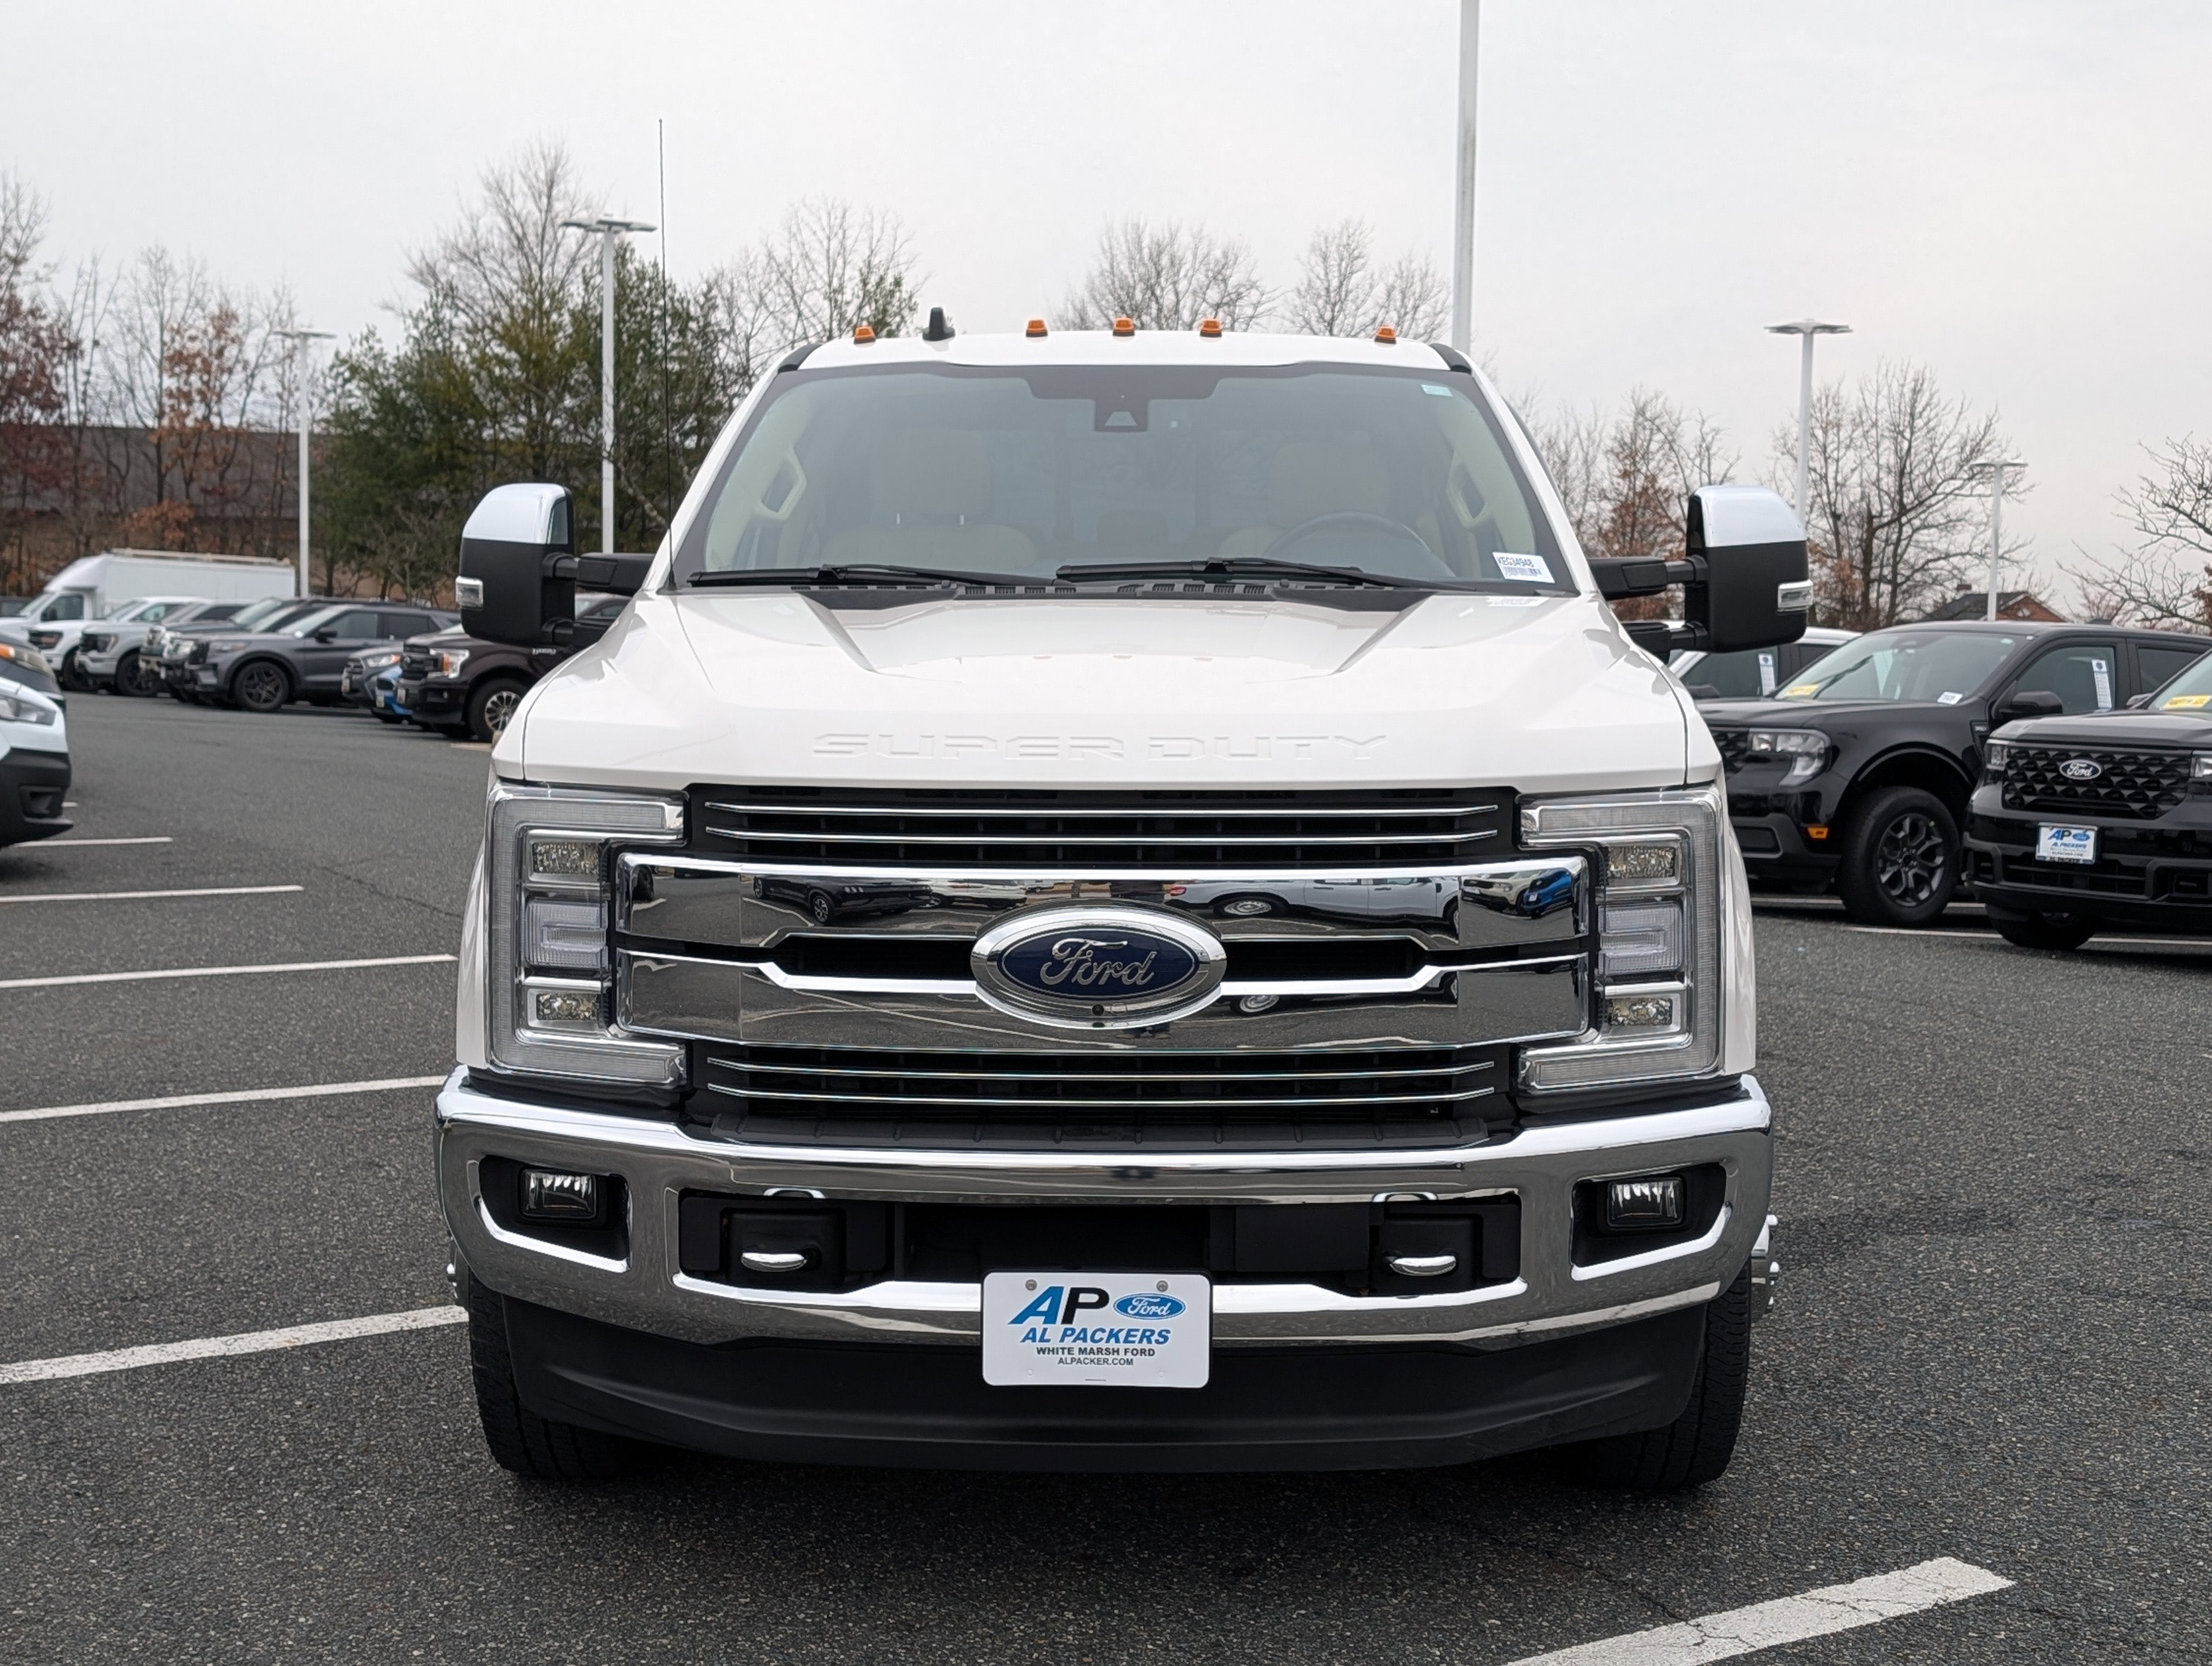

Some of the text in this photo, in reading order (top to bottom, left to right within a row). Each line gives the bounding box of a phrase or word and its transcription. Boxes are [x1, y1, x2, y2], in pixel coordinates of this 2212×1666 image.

[812, 734, 1387, 760] SUPER DUTY
[2067, 762, 2093, 777] Ford
[2048, 830, 2072, 840] AP
[1040, 938, 1157, 985] Ford
[1008, 1286, 1170, 1325] AP Ford
[1020, 1327, 1171, 1344] AL PACKERS
[1036, 1347, 1155, 1356] WHITE MARSH FORD
[1058, 1357, 1134, 1366] ALPACKER.COM
